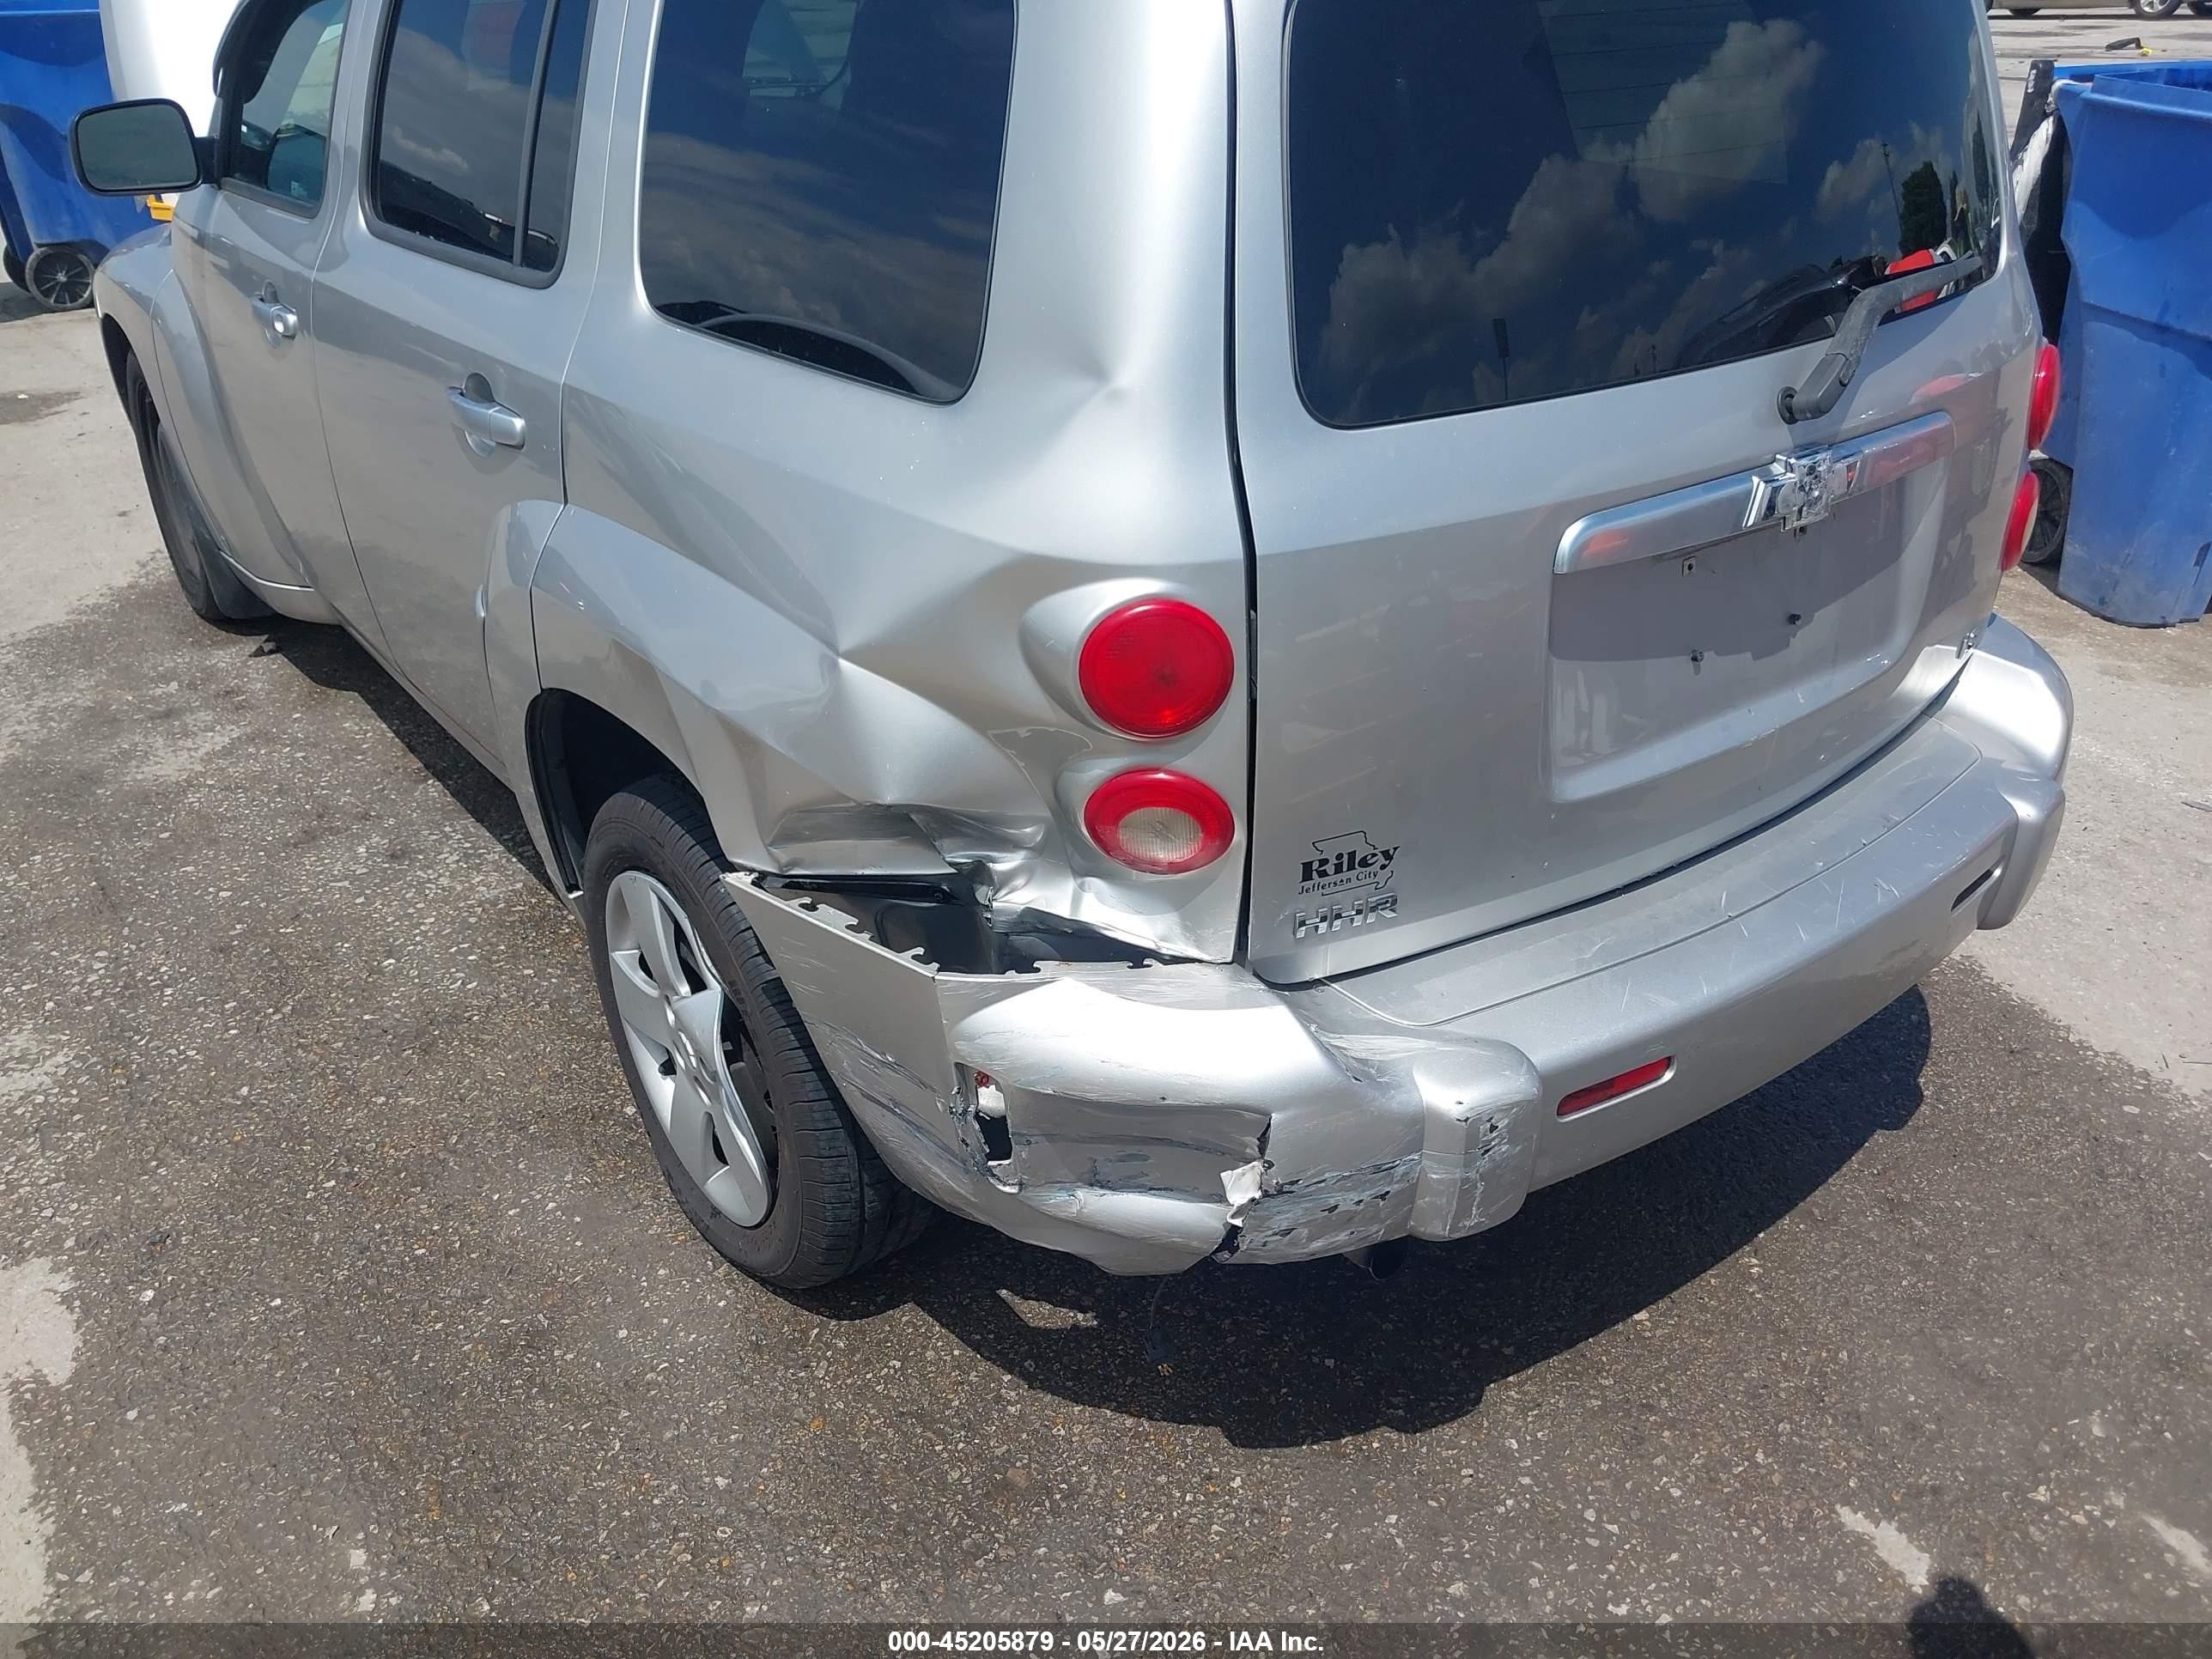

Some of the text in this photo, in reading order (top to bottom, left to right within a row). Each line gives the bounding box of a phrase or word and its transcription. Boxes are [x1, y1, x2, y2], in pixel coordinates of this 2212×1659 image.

[1299, 846, 1401, 884] Riley
[1356, 870, 1378, 882] City
[1293, 892, 1398, 939] HHR
